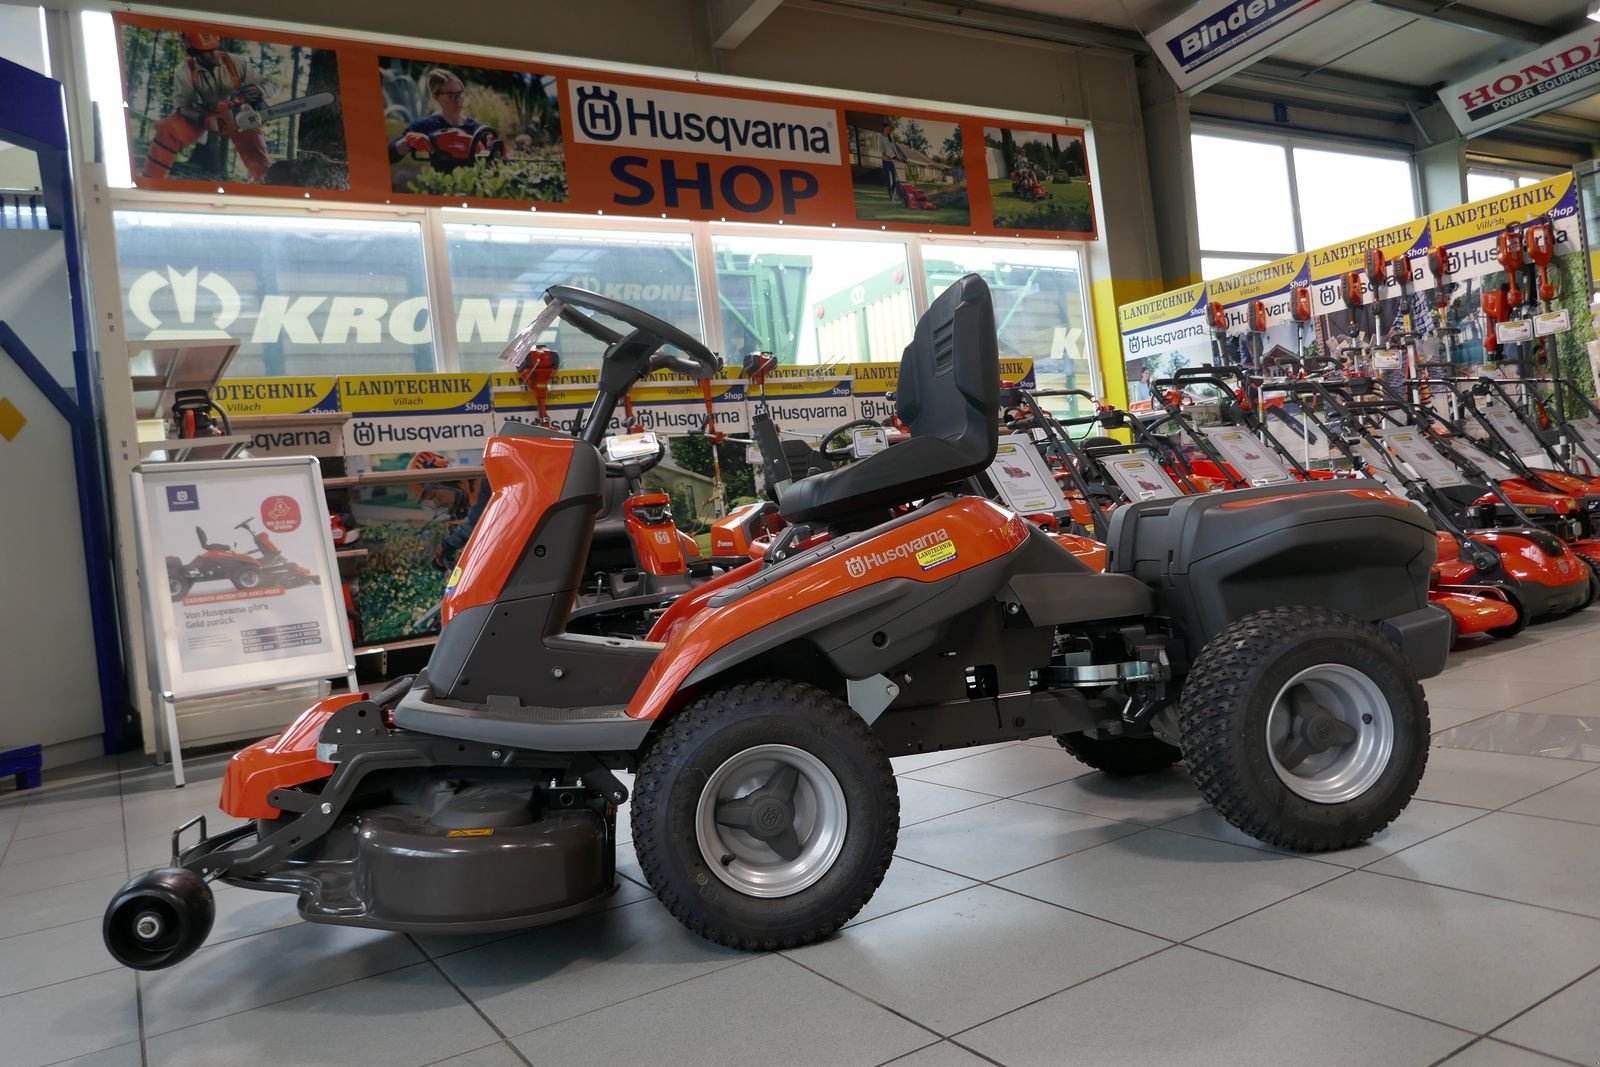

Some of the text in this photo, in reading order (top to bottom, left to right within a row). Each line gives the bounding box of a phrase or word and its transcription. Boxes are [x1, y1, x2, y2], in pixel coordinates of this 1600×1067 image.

[1180, 0, 1276, 59] Binder
[1459, 37, 1600, 110] HOND
[1493, 60, 1600, 111] POWER EQUIPMEN
[626, 97, 831, 154] Husqvarna
[610, 155, 819, 215] SHOP
[1435, 184, 1556, 232] LANDTECHNIK
[1547, 205, 1574, 218] Shop
[1313, 227, 1413, 267] LANDTECHNIK
[1406, 247, 1429, 258] Shop
[1210, 261, 1296, 296] LANDTECHNIK
[1290, 279, 1308, 289] Shop
[603, 284, 697, 301] KRONE
[1240, 286, 1260, 296] Villach
[1123, 290, 1196, 320] LANDTECHNIK
[1050, 327, 1090, 360] K
[1141, 323, 1204, 349] Husqvarna
[854, 367, 899, 380] LANDTE
[215, 383, 318, 401] DTECHNIK
[344, 378, 473, 397] LANDTECHNIK
[667, 387, 692, 395] Villach
[782, 383, 803, 391] Villach
[832, 388, 850, 396] Shop
[393, 397, 424, 406] Villach
[724, 392, 743, 401] Shop
[227, 402, 261, 412] Villach
[464, 402, 489, 413] Shop
[772, 405, 847, 421] Husqvarna
[655, 410, 740, 427] Husqvrna
[246, 429, 331, 451] sqvarna
[377, 422, 485, 443] Husqvarna
[865, 528, 949, 570] Husqvarna
[917, 541, 953, 560] LANDTECHNIK
[184, 611, 201, 619] Von
[202, 606, 246, 618] Husqvarna
[185, 619, 205, 629] Geld
